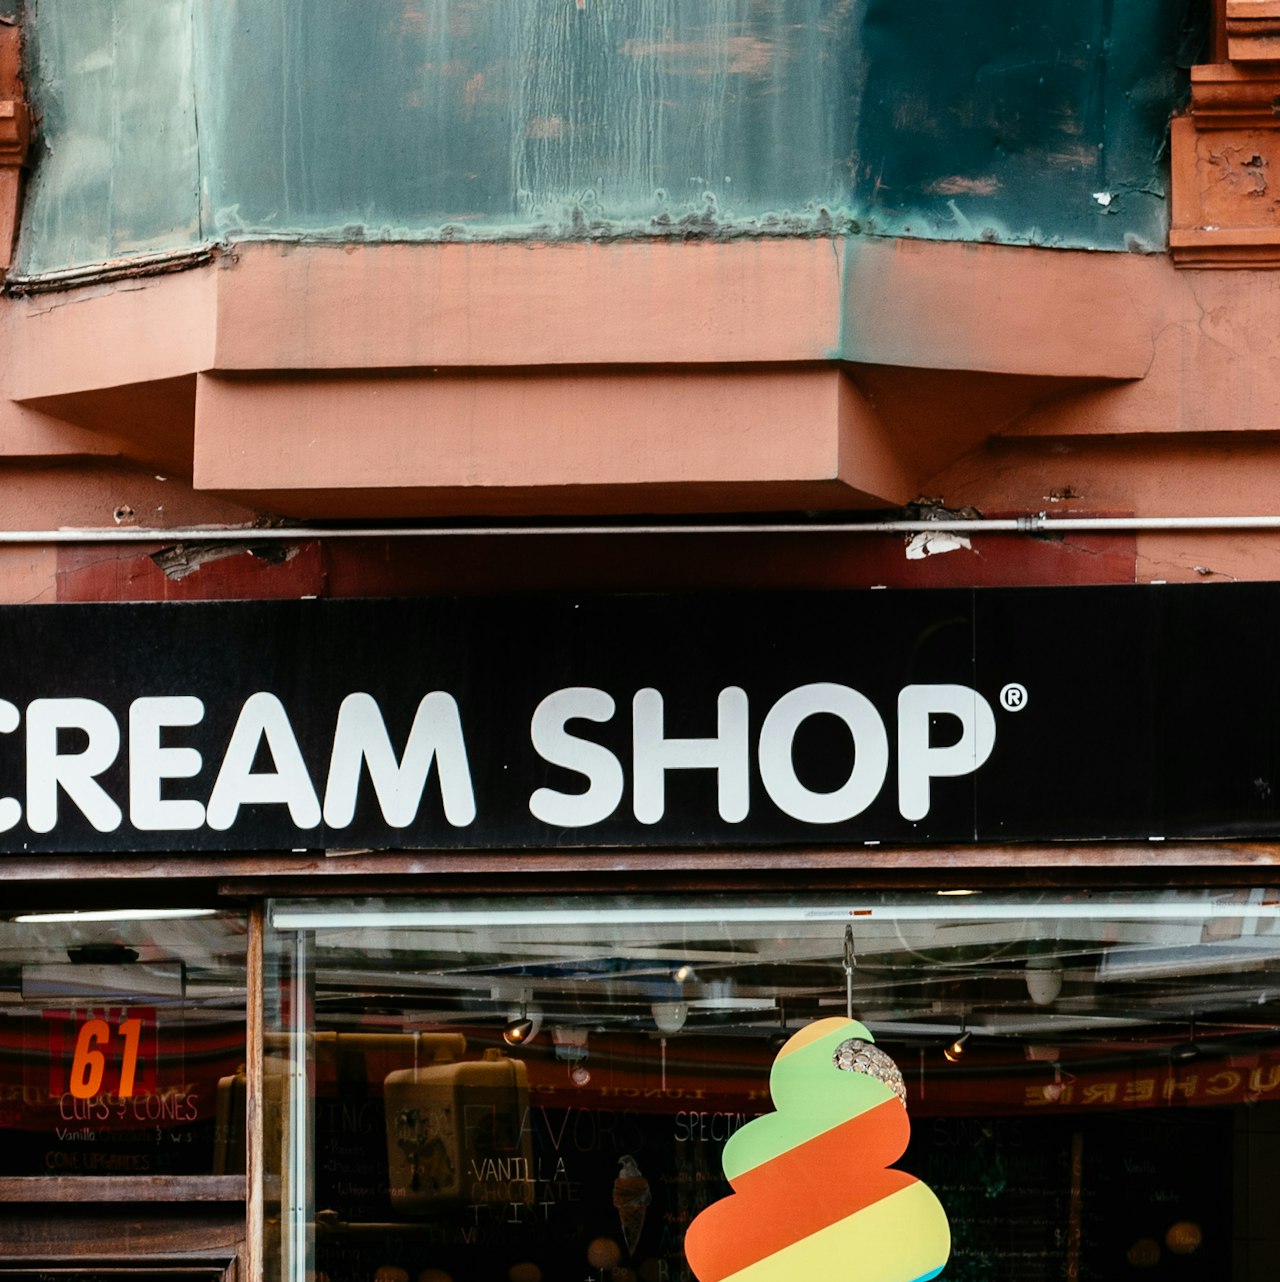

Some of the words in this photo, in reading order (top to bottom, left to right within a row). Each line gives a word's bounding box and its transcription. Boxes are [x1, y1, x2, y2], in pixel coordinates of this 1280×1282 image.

[70, 1018, 142, 1099] 61
[131, 1093, 198, 1121] CONES
[55, 1126, 96, 1143] Vanilla
[470, 1156, 569, 1183] VANILLA
